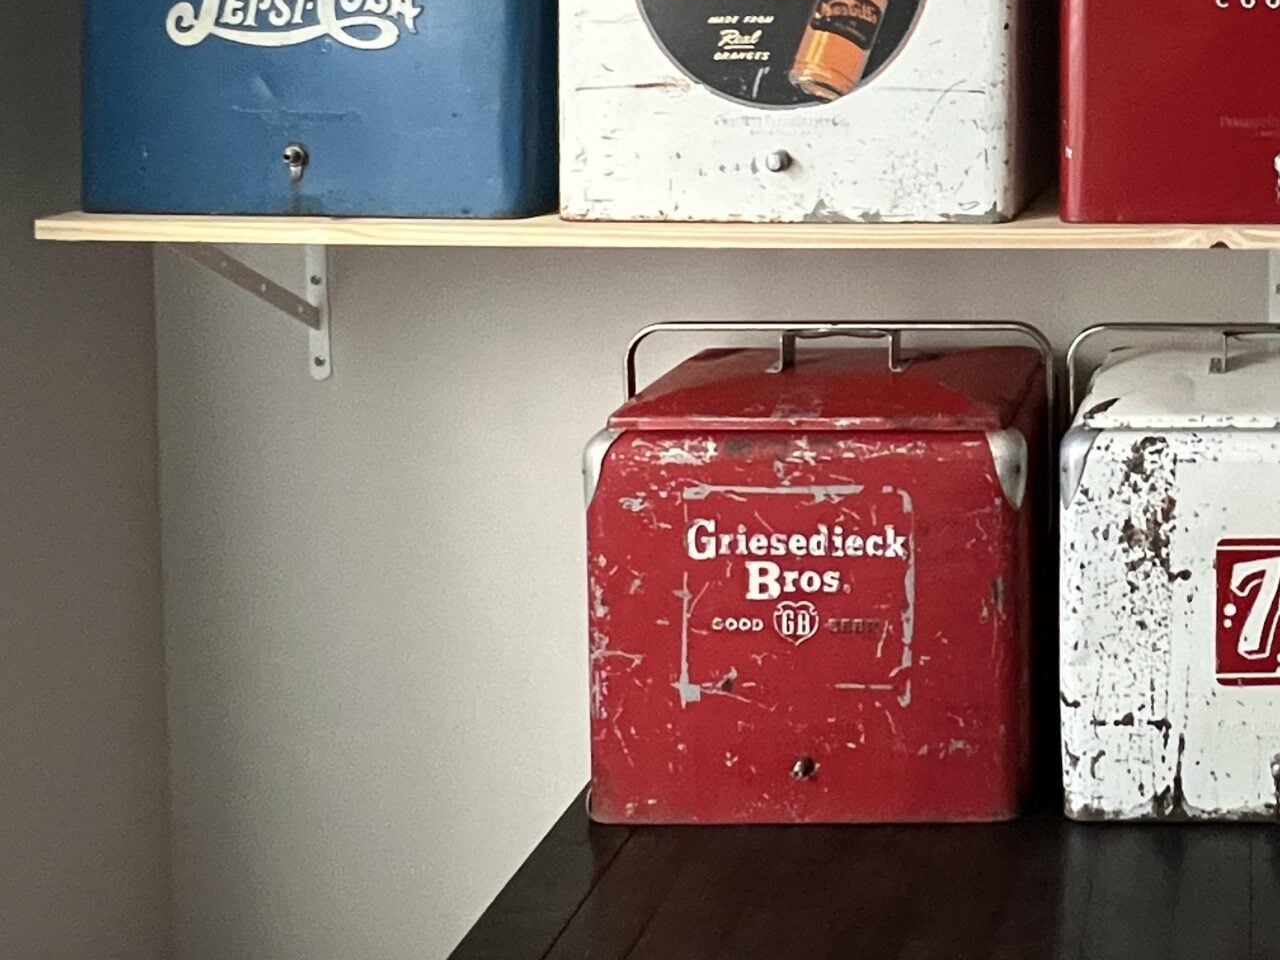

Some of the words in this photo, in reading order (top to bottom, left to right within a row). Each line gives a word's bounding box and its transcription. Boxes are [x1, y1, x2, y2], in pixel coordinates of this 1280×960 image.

[713, 51, 771, 61] ORANGES
[687, 518, 908, 560] Griesedieck
[711, 617, 764, 632] GOOD
